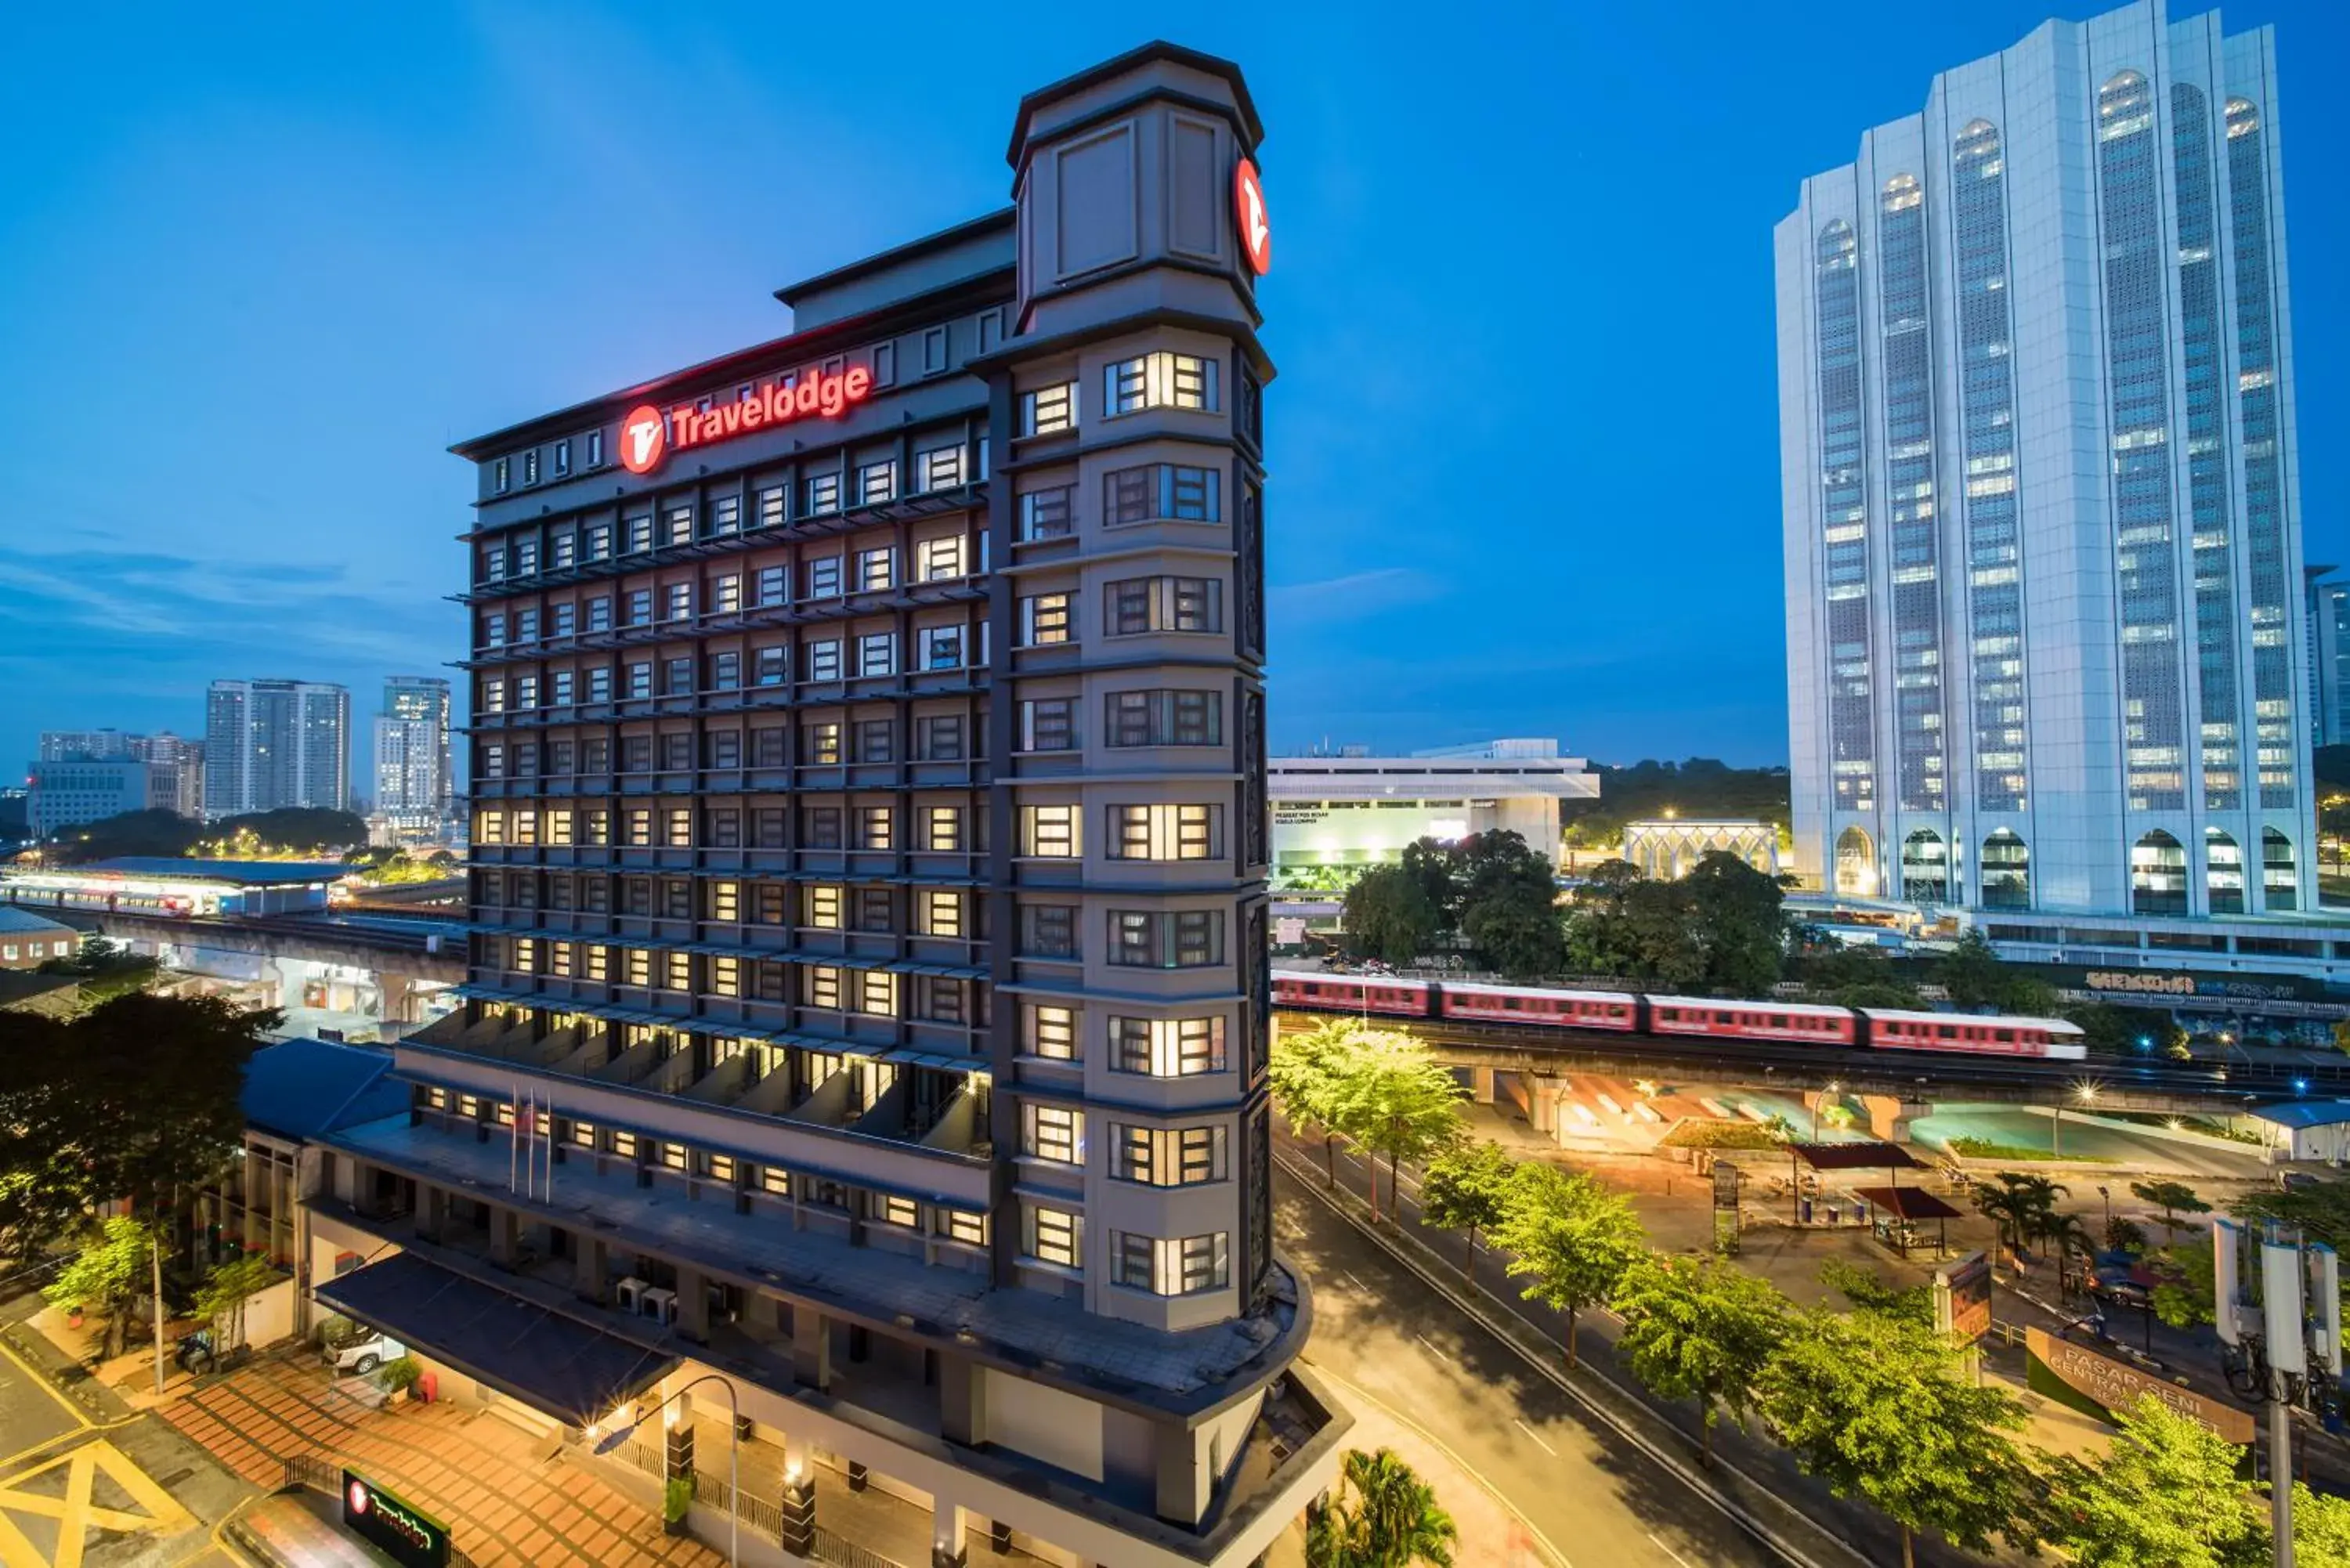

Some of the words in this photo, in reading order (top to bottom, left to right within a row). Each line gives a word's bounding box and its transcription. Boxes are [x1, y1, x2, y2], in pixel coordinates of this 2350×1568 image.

[672, 367, 870, 447] Travelodge
[2066, 1348, 2140, 1390] PASAR
[2147, 1383, 2201, 1413] SENI
